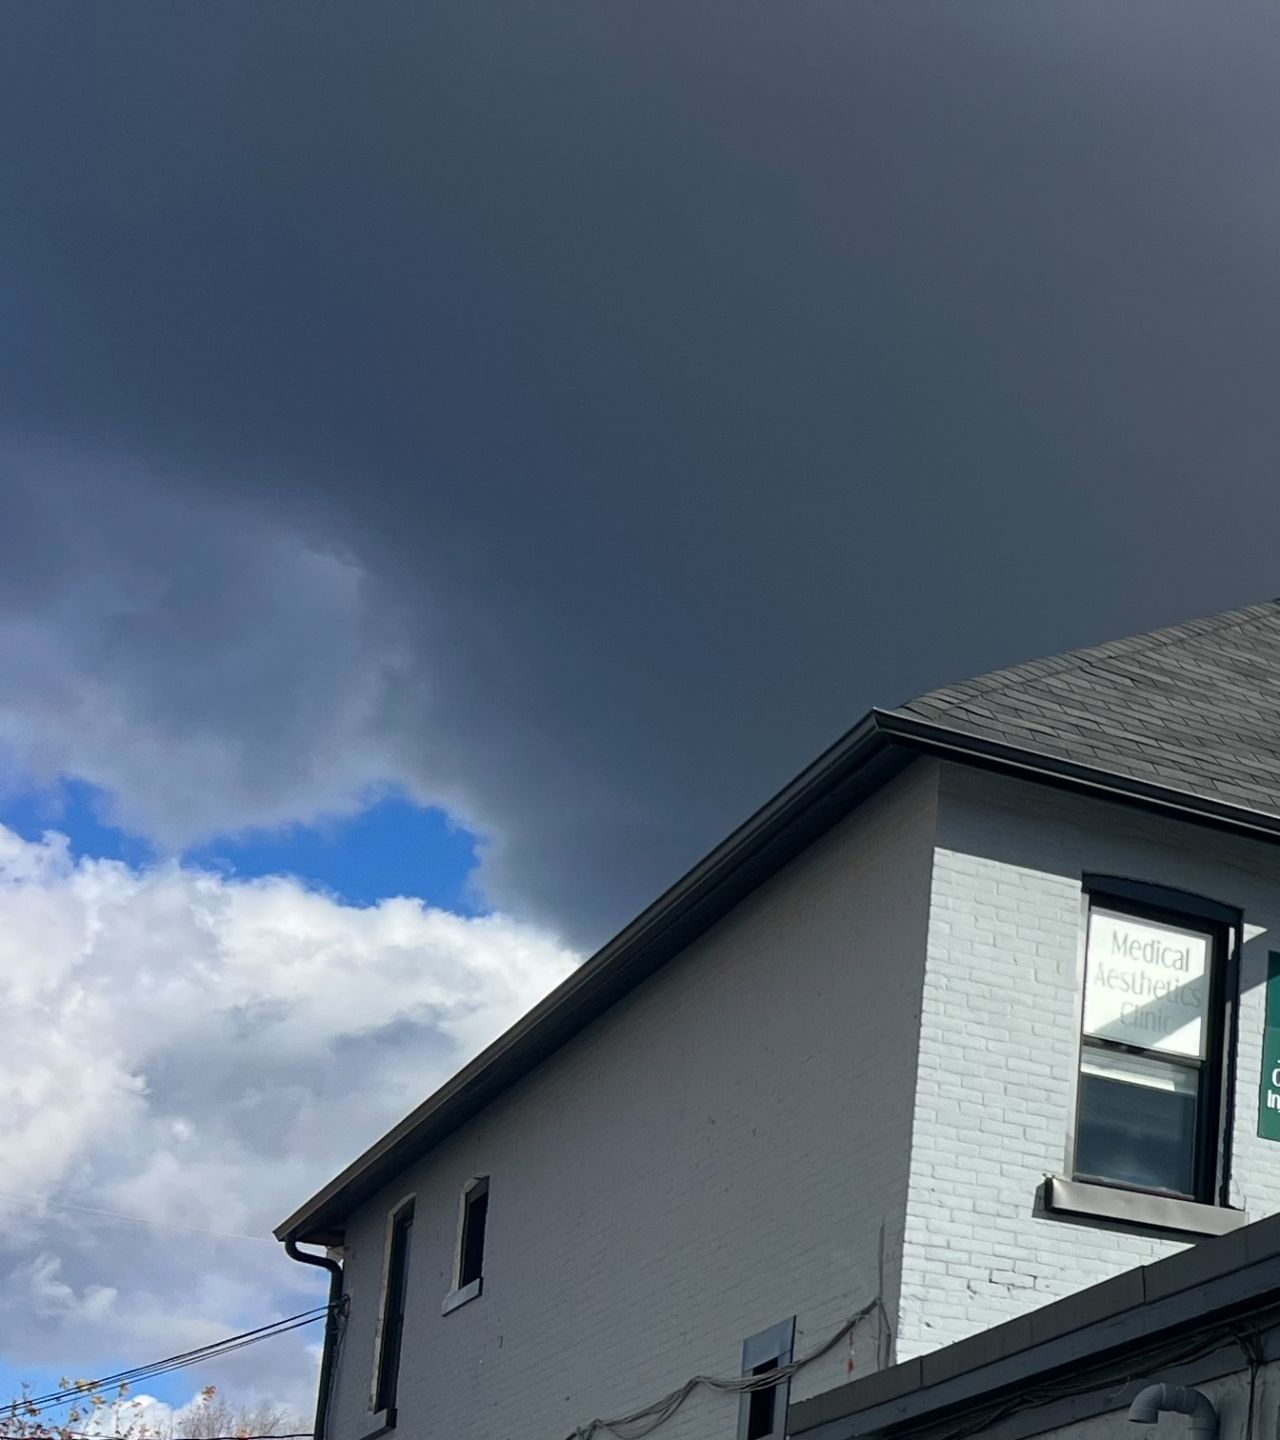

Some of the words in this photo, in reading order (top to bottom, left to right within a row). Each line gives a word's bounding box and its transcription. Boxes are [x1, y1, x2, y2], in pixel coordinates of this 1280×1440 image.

[1110, 929, 1191, 973] Medical
[1094, 960, 1201, 1009] Aesthetics
[1119, 1001, 1174, 1034] Clinic
